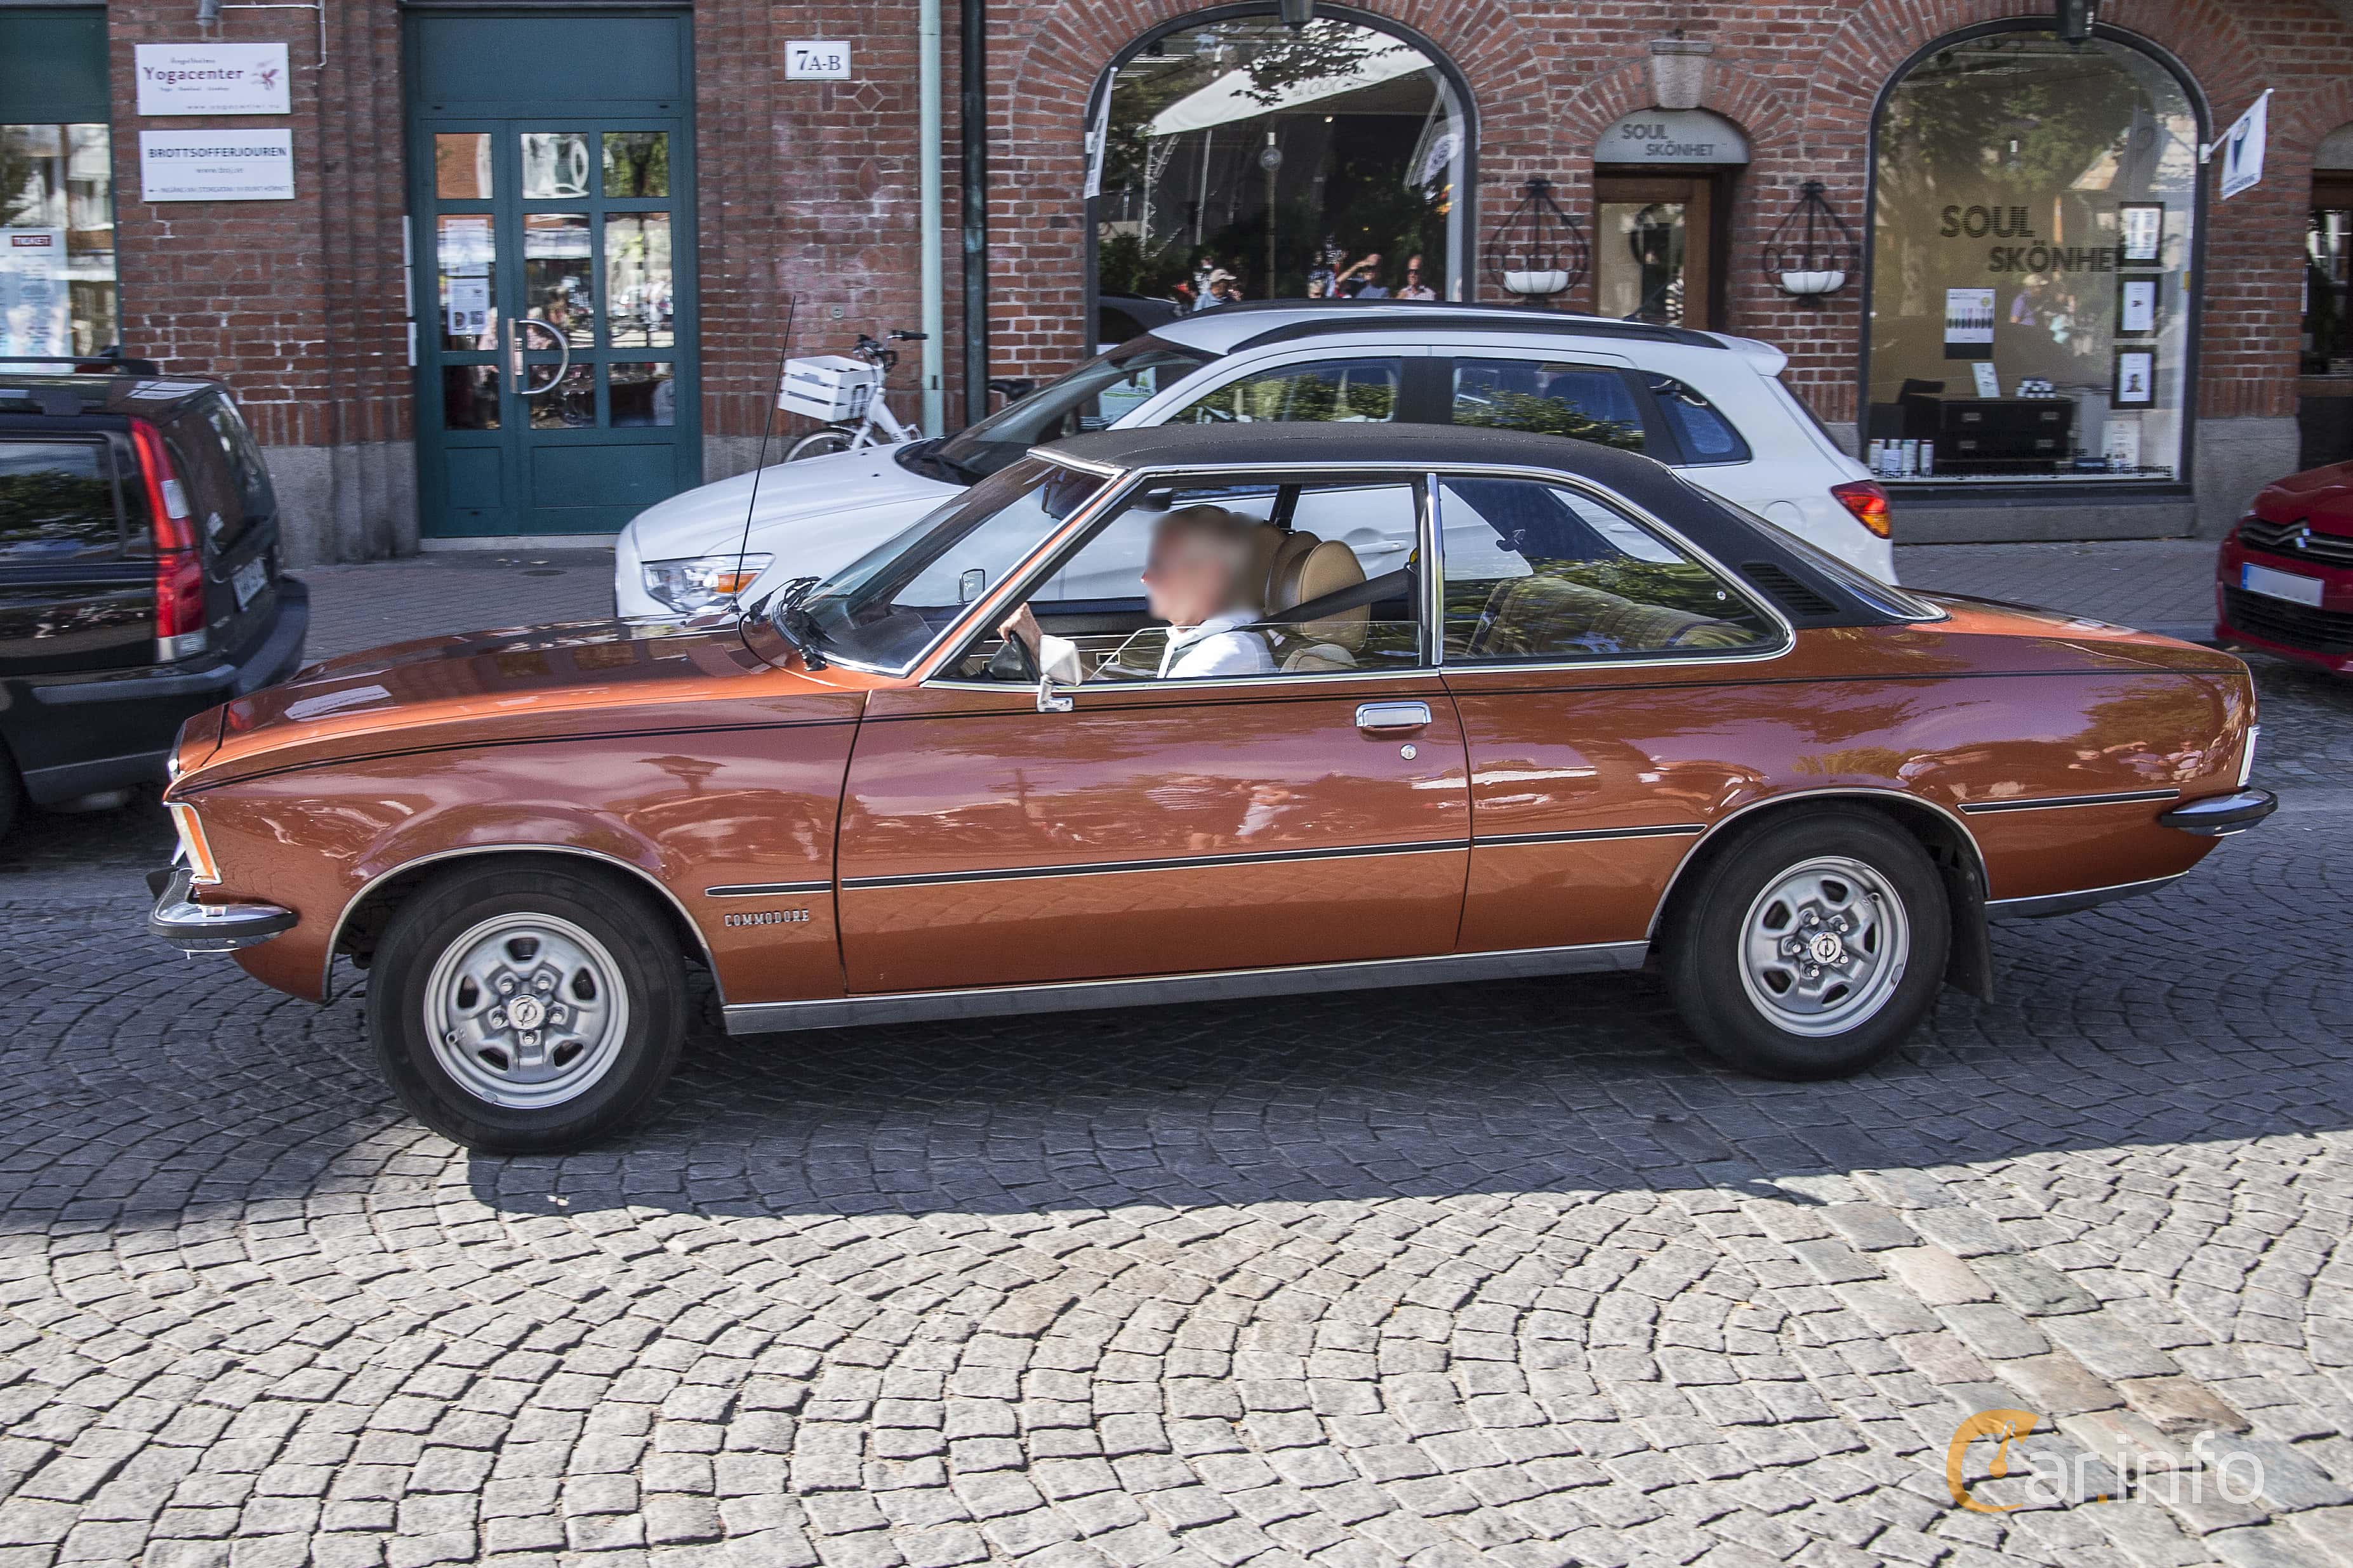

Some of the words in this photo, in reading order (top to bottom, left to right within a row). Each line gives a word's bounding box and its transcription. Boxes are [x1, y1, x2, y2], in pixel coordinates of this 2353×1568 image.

[796, 49, 841, 70] 7A-B
[143, 66, 244, 84] Yogacenter
[1621, 123, 1669, 140] SOUL
[148, 147, 288, 158] BROTTSOFFERJOUREN
[1645, 140, 1716, 157] SKÖNHET
[1940, 204, 2036, 238] SOUL
[724, 909, 810, 927] COMMODORE
